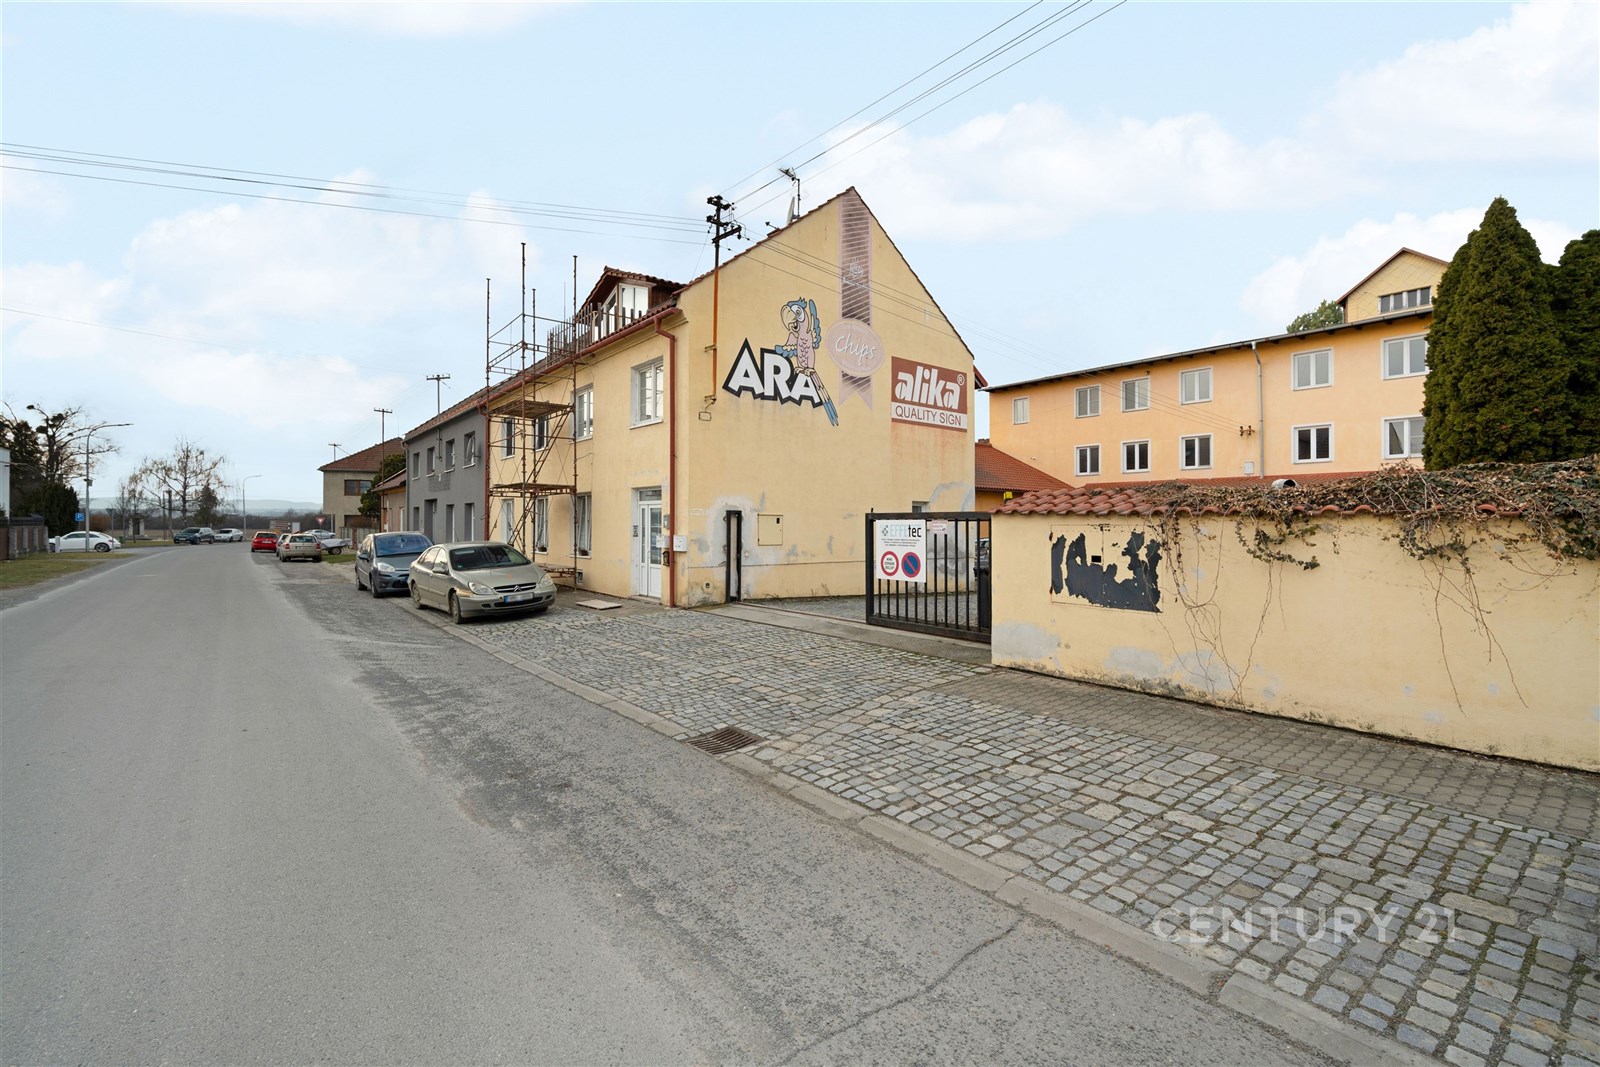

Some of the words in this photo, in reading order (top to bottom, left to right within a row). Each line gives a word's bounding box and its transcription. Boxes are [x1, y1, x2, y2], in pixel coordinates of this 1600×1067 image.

[835, 333, 875, 367] Chips
[722, 338, 823, 408] ARA
[895, 406, 936, 423] QUALITY
[939, 412, 962, 426] SIGN
